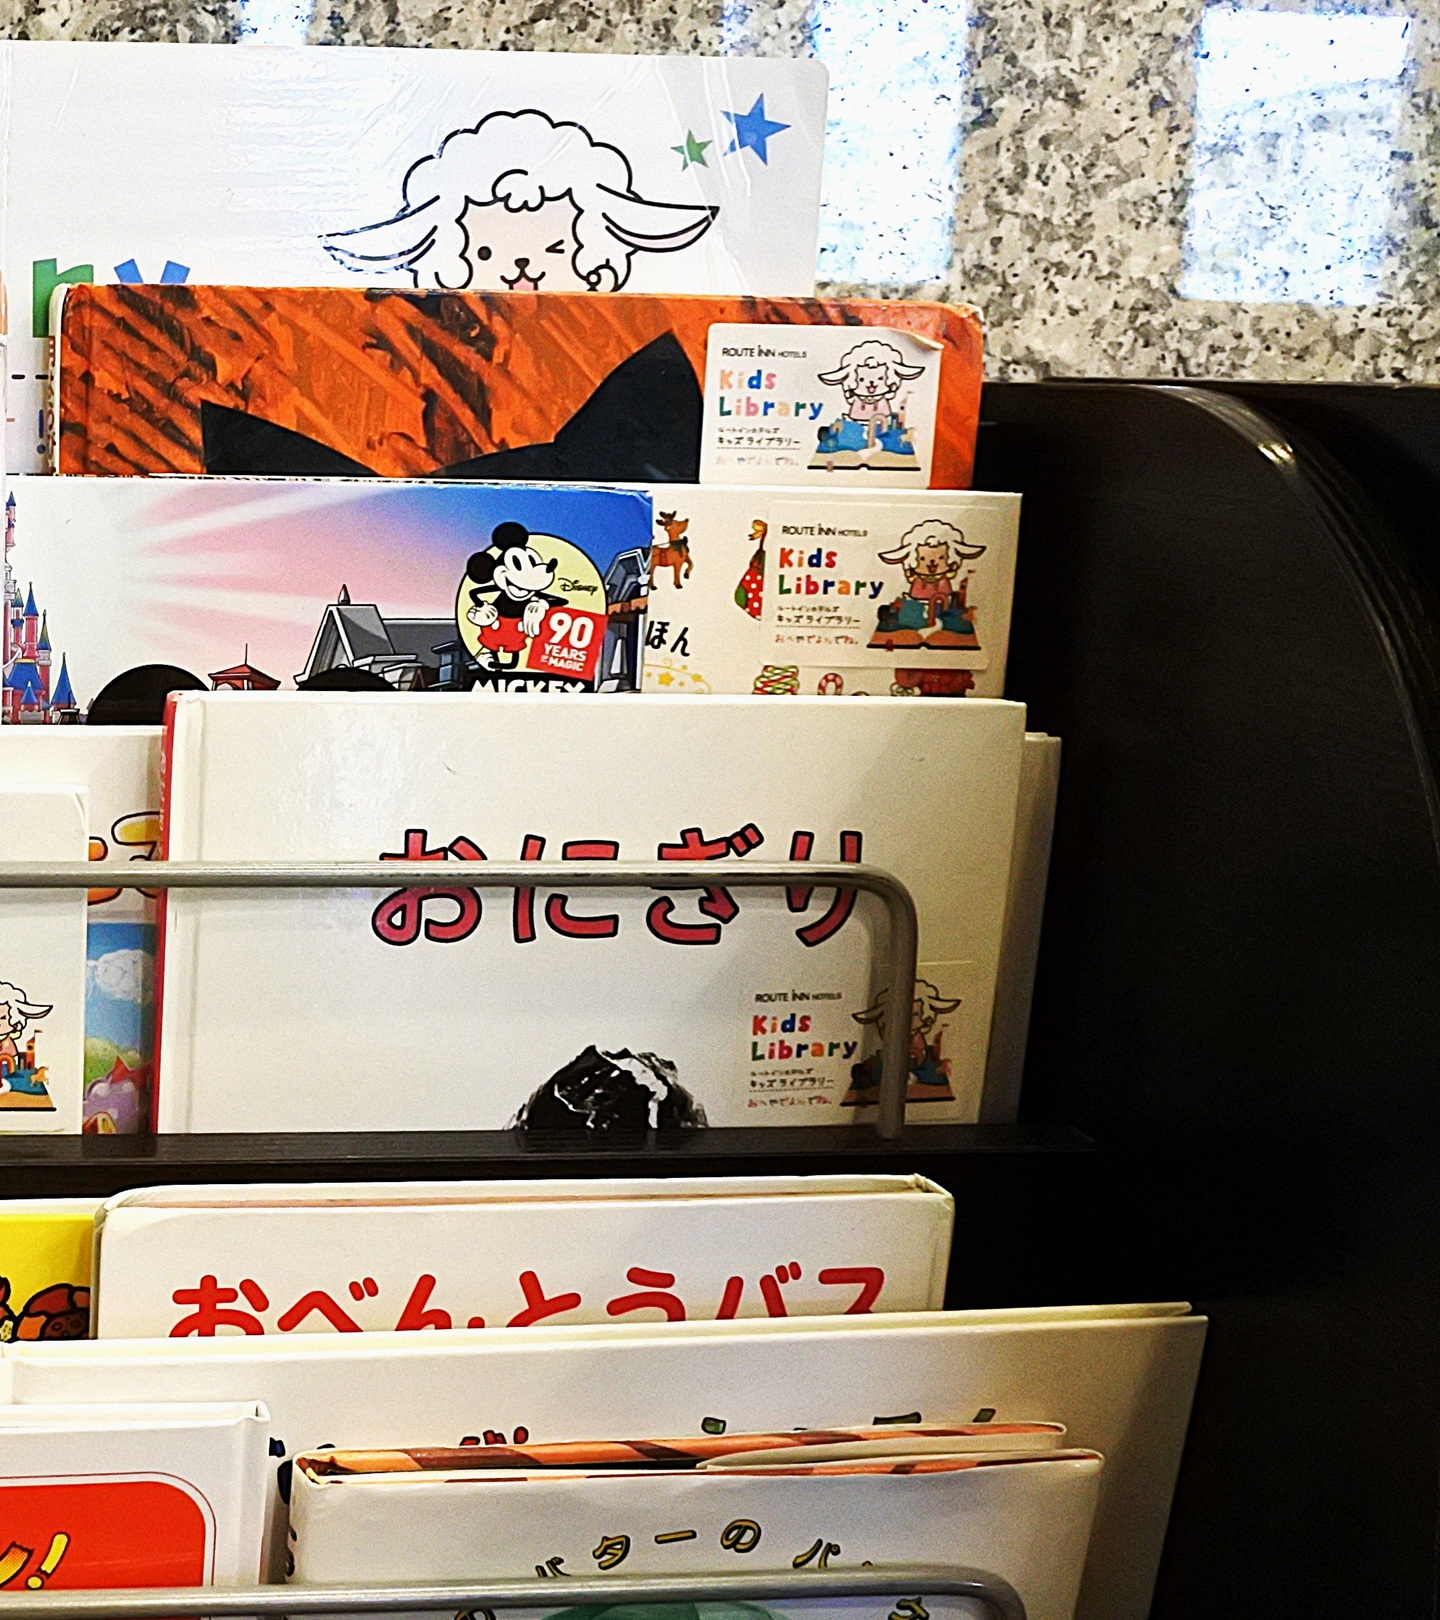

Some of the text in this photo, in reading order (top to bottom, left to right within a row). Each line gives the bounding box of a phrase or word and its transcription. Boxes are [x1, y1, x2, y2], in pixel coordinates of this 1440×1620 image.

[722, 347, 755, 357] ROUTE
[719, 369, 777, 390] Kids
[719, 396, 823, 420] Library
[781, 525, 816, 537] ROUTE
[778, 547, 838, 568] Kids
[778, 574, 884, 599] Library
[549, 611, 594, 649] 90
[544, 643, 587, 661] YEARS
[548, 657, 584, 673] MAGIC
[371, 823, 863, 947] おにぎり
[755, 991, 789, 1003] ROUTE
[752, 1013, 812, 1036] Kids
[751, 1039, 858, 1062] Library
